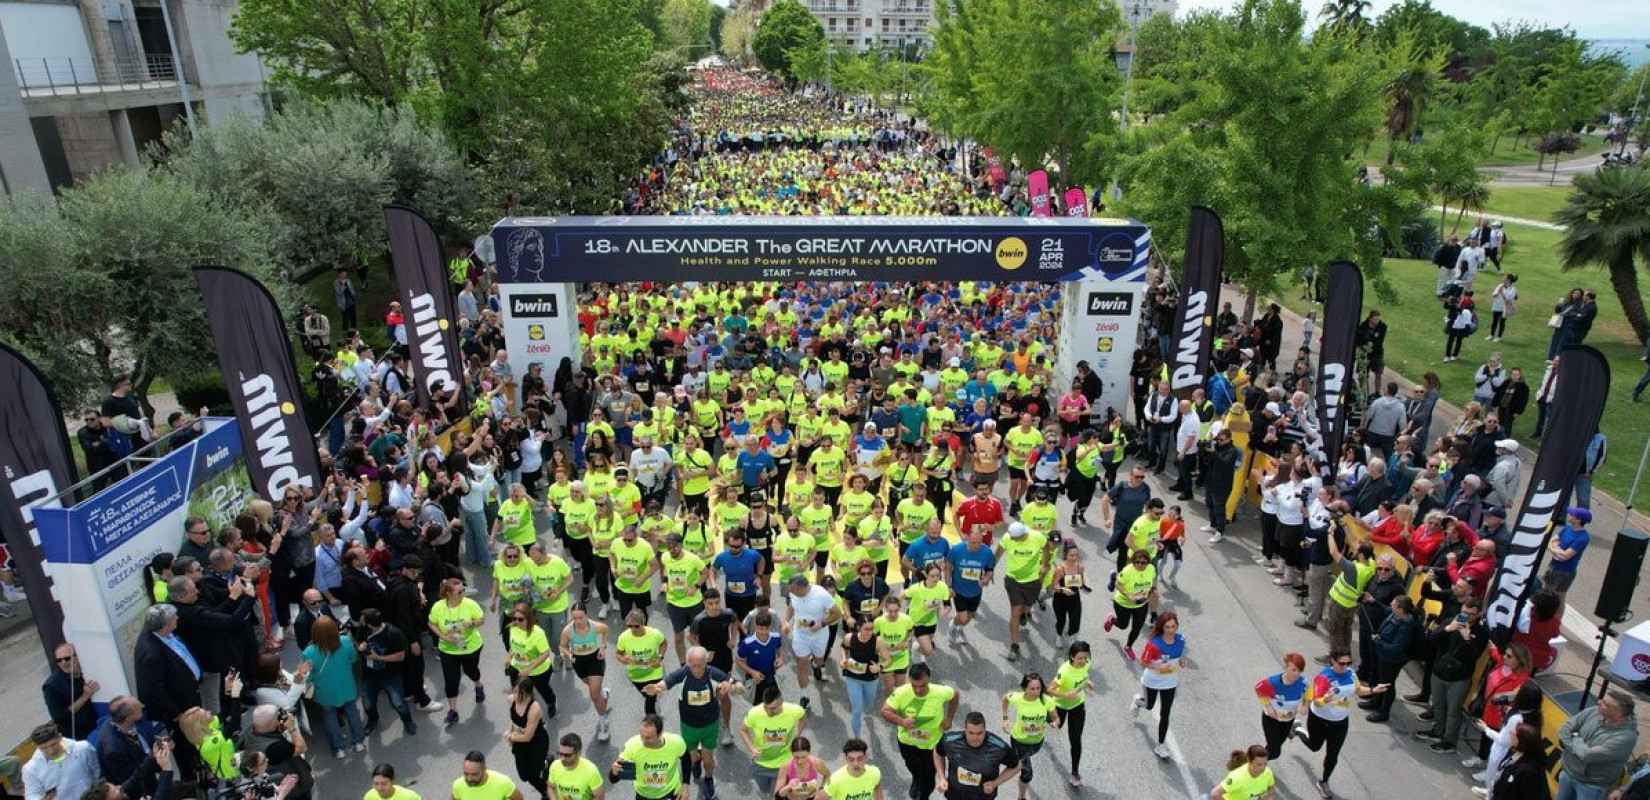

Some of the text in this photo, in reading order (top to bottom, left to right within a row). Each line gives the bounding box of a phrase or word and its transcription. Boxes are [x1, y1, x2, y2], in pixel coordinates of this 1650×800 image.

[625, 238, 749, 254] ALEXANDER
[755, 239, 792, 254] The
[795, 238, 865, 254] GREAT
[869, 239, 992, 254] MARATHON
[1041, 238, 1064, 251] 21
[998, 247, 1024, 258] bwin
[1039, 252, 1064, 262] APR
[680, 256, 938, 267] Health and Power Walking Race 5.000m
[1038, 261, 1063, 269] 2024
[762, 268, 791, 277] START
[808, 268, 857, 277] ΑΦΕΤΗΡΙΑ
[514, 298, 552, 313] bwin
[1090, 295, 1128, 311] bwin
[206, 446, 230, 468] bwin
[104, 555, 132, 577] ΠΕΛΛΑ
[643, 761, 669, 770] bwin
